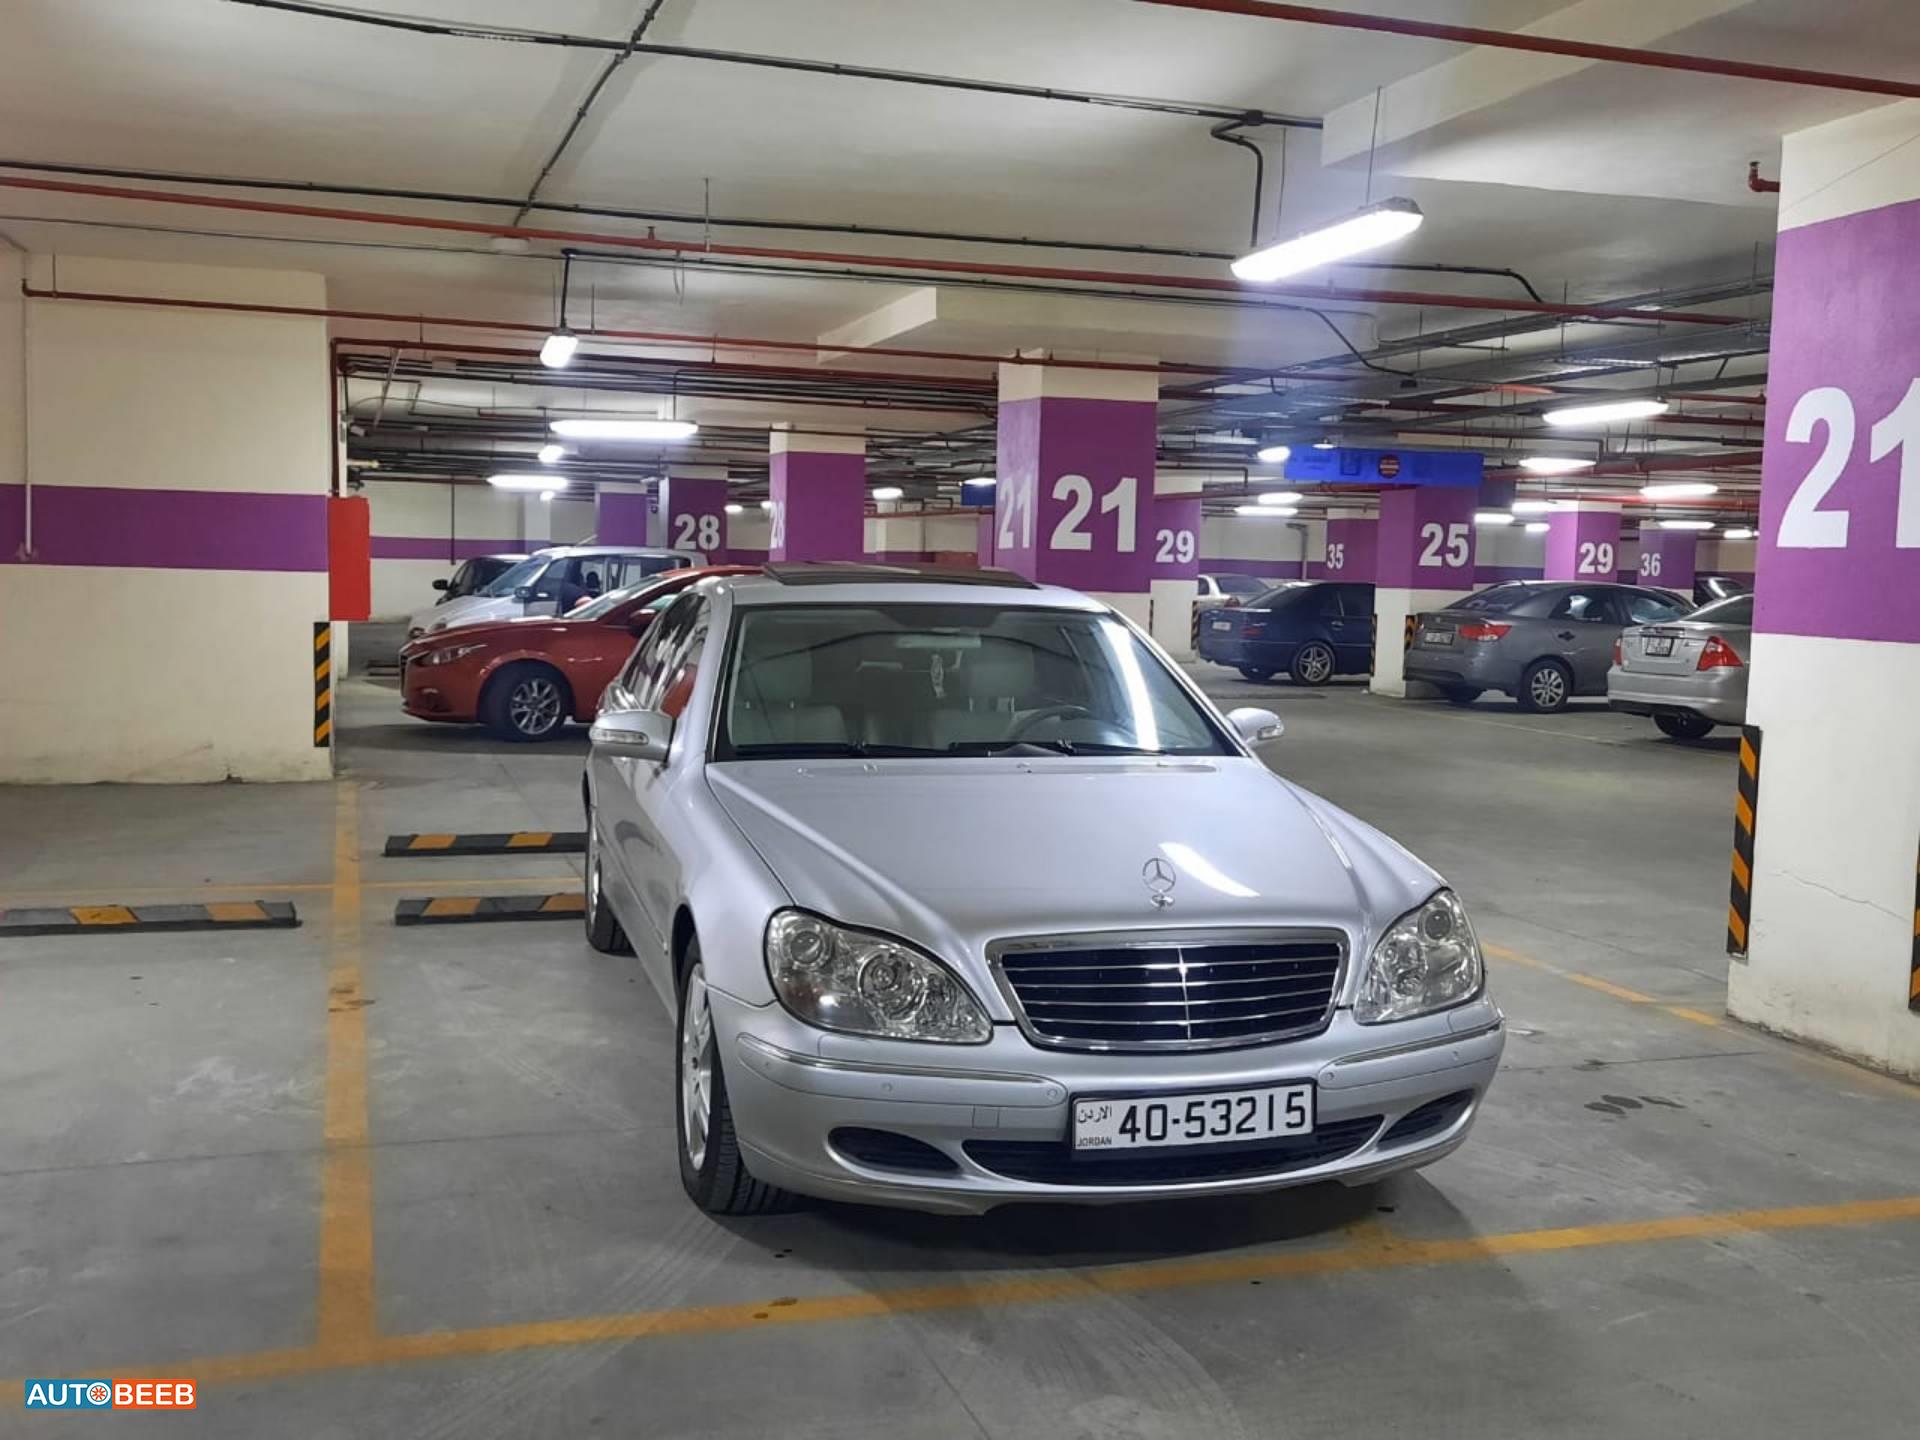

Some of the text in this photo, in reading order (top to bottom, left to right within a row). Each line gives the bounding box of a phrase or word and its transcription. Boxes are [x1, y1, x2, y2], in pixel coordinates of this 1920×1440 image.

[1777, 378, 1920, 548] 21
[674, 513, 720, 550] 28
[998, 477, 1032, 549] 21
[1050, 475, 1138, 552] 21
[1155, 529, 1195, 563] 29
[1326, 543, 1345, 570] 35
[1419, 523, 1469, 568] 25
[1578, 542, 1614, 574] 29
[1640, 552, 1661, 577] 36
[1119, 1091, 1306, 1143] 40-53215
[1077, 1136, 1112, 1147] JORDAN
